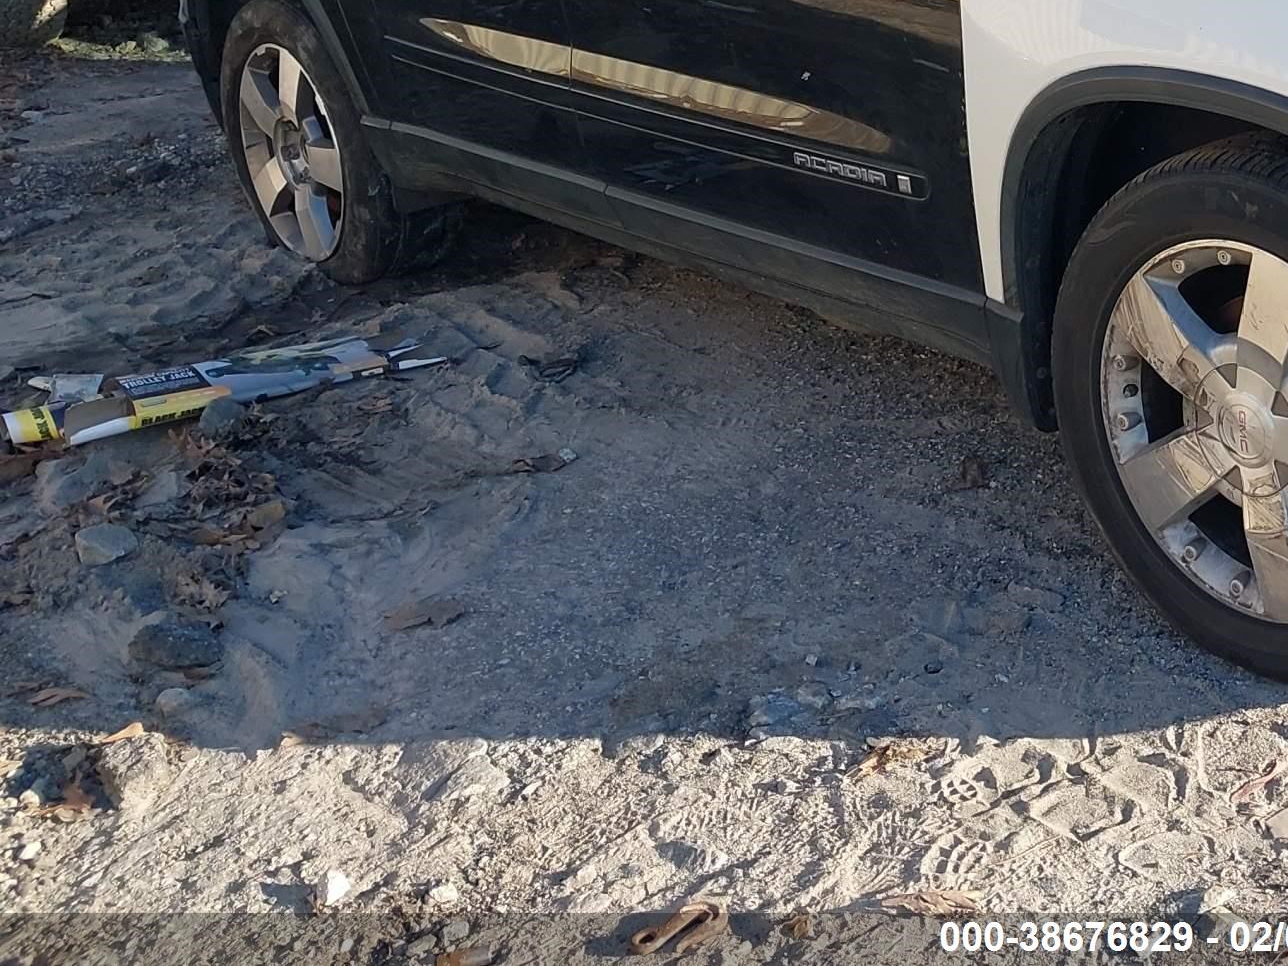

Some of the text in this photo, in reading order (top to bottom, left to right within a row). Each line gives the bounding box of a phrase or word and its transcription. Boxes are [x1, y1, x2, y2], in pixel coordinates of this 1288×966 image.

[793, 152, 887, 187] ACADIA
[122, 375, 167, 389] TROLLEY
[168, 370, 196, 382] JACK
[141, 412, 177, 427] BLACK
[1238, 409, 1249, 453] GMC
